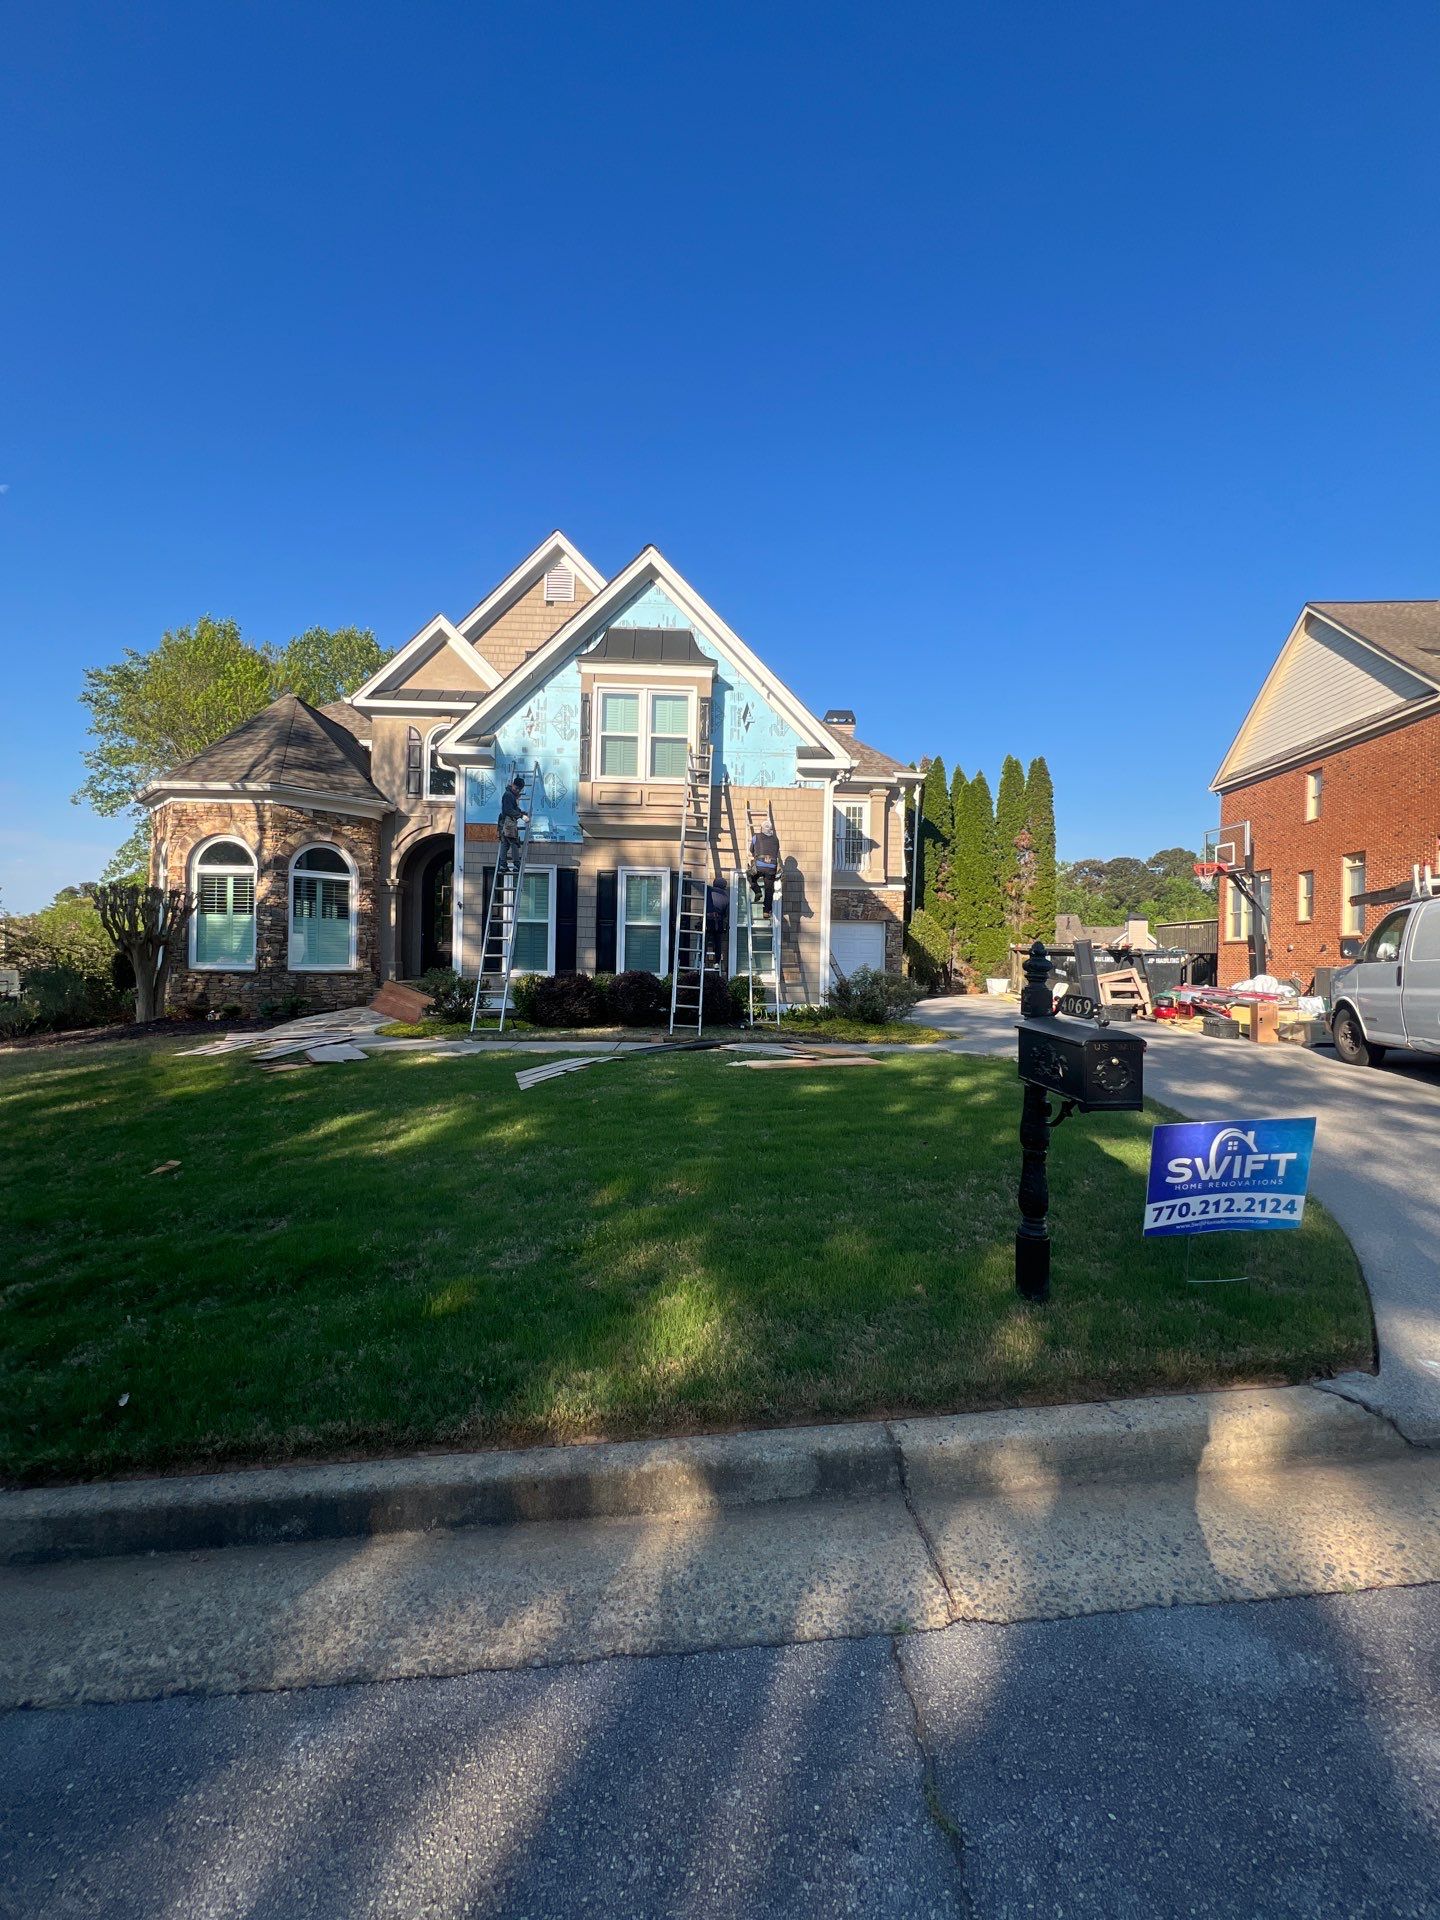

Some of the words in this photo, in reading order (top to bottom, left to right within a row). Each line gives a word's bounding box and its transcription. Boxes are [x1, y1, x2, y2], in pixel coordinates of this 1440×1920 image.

[1061, 997, 1091, 1015] 4069
[1164, 1151, 1297, 1184] SWIFT
[1174, 1182, 1202, 1191] HOME
[1208, 1178, 1284, 1188] RENOVATIONS
[1152, 1196, 1297, 1222] 770.212.2124
